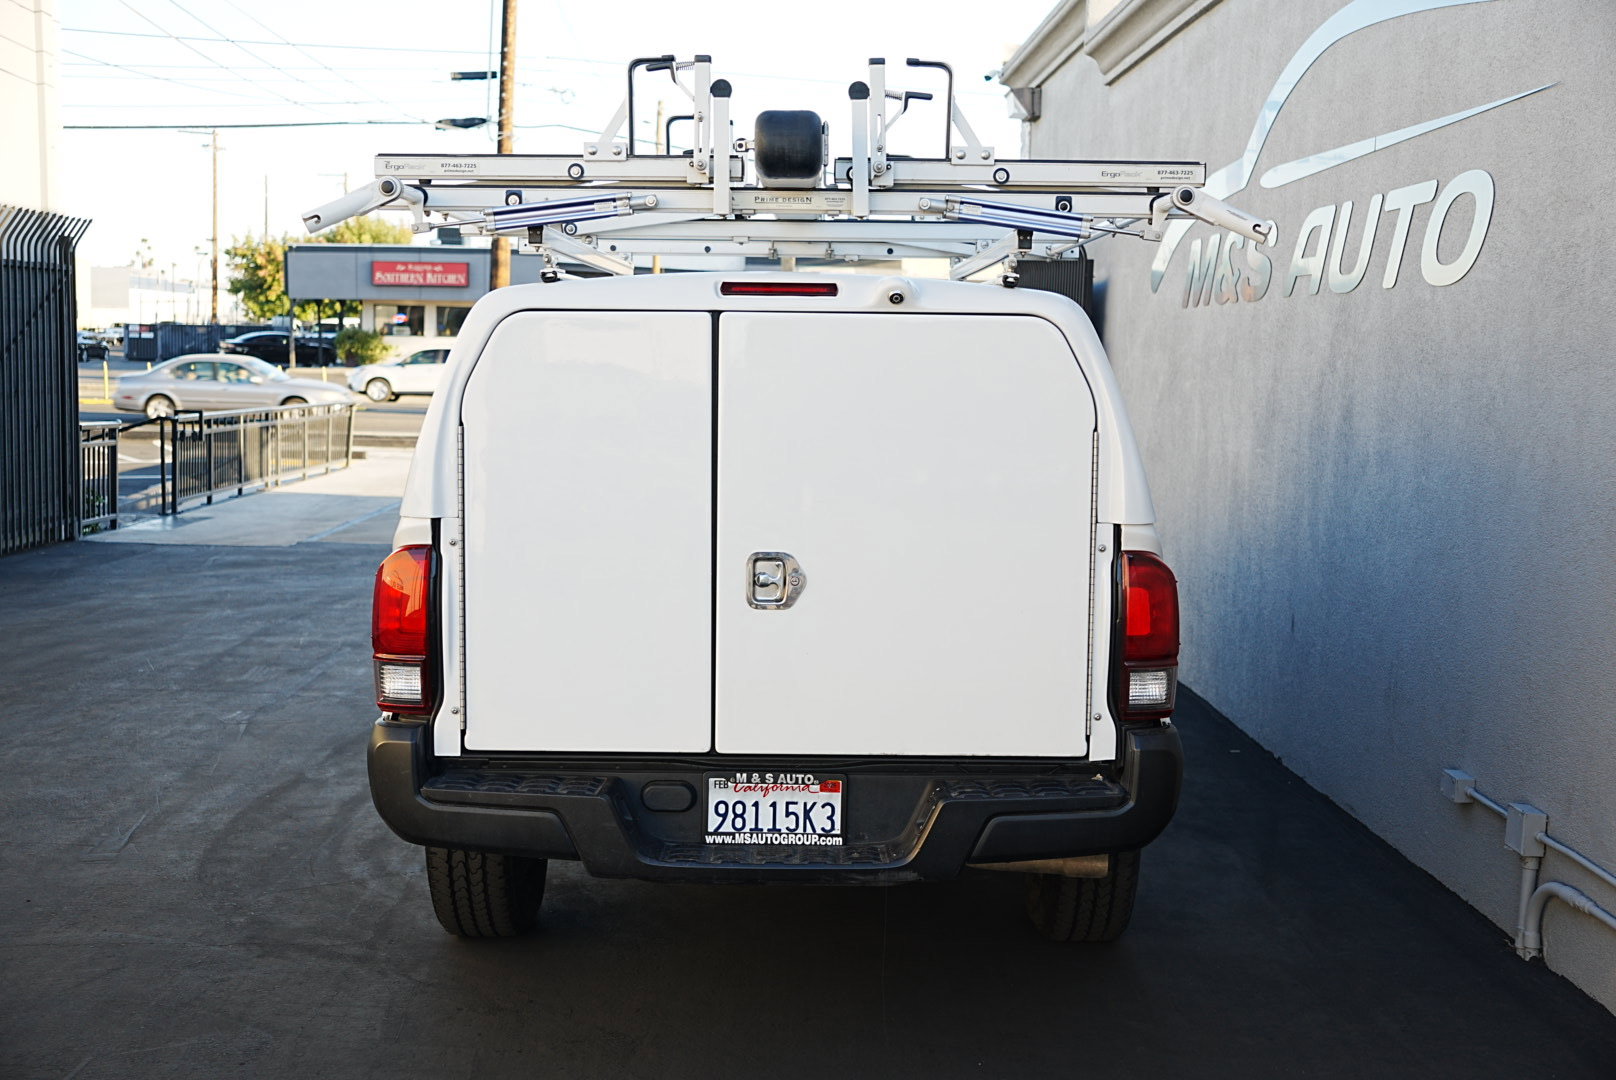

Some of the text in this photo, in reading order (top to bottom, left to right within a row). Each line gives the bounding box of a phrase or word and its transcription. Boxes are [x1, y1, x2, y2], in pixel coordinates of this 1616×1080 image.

[1181, 169, 1495, 309] M&S AUTO
[714, 780, 728, 789] FEB
[735, 773, 747, 783] M
[751, 773, 761, 783] &
[765, 773, 774, 784] S
[777, 774, 814, 785] AUTO
[733, 784, 820, 797] California
[713, 800, 836, 833] 98115K3
[705, 833, 843, 846] www.MSAUTOGROUP.com
